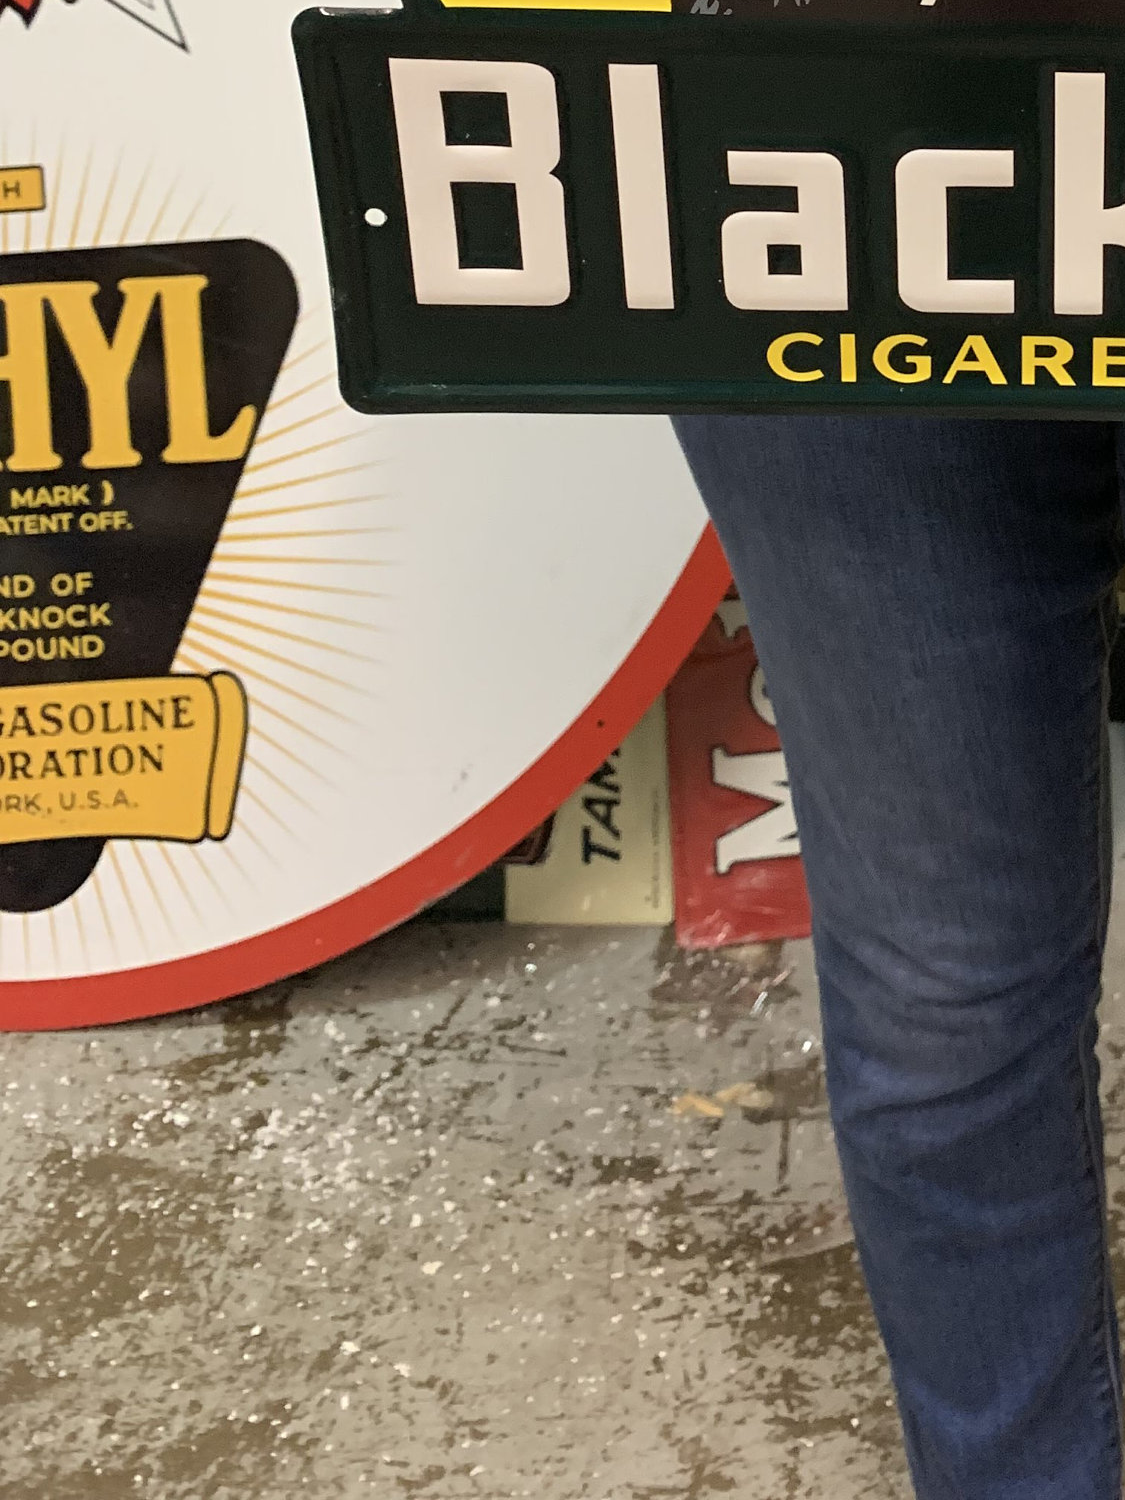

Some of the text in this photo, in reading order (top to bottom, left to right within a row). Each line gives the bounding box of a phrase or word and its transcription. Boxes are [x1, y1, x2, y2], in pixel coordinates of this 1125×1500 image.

[10, 483, 91, 509] MARK
[79, 510, 134, 532] OFF.
[51, 571, 94, 597] OF
[0, 695, 195, 737] ASOLINE
[0, 744, 164, 780] RATION
